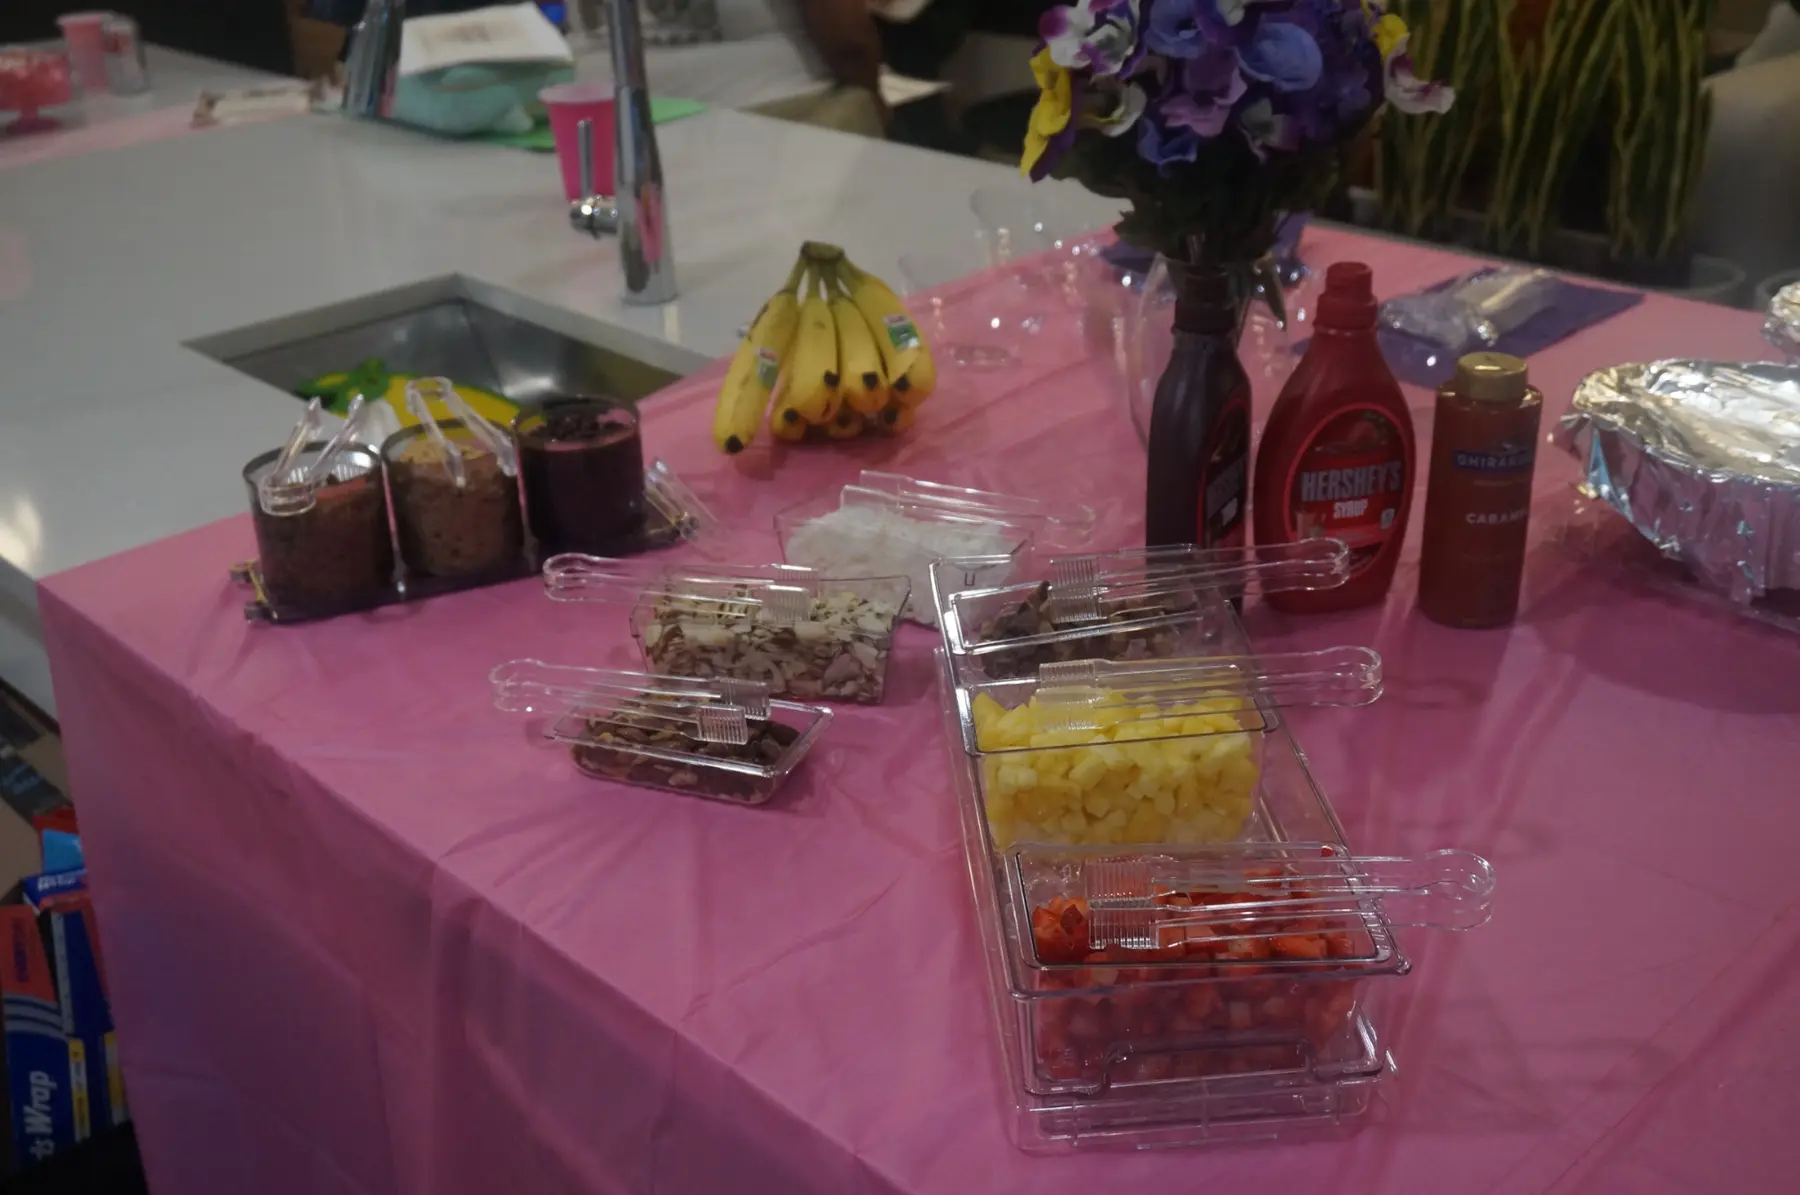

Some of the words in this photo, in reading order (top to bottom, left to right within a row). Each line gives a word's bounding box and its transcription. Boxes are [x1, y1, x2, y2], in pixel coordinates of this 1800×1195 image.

[1301, 460, 1402, 502] HERSHEY'S
[1333, 498, 1369, 520] SYRUP
[22, 1070, 57, 1135] Wrap
